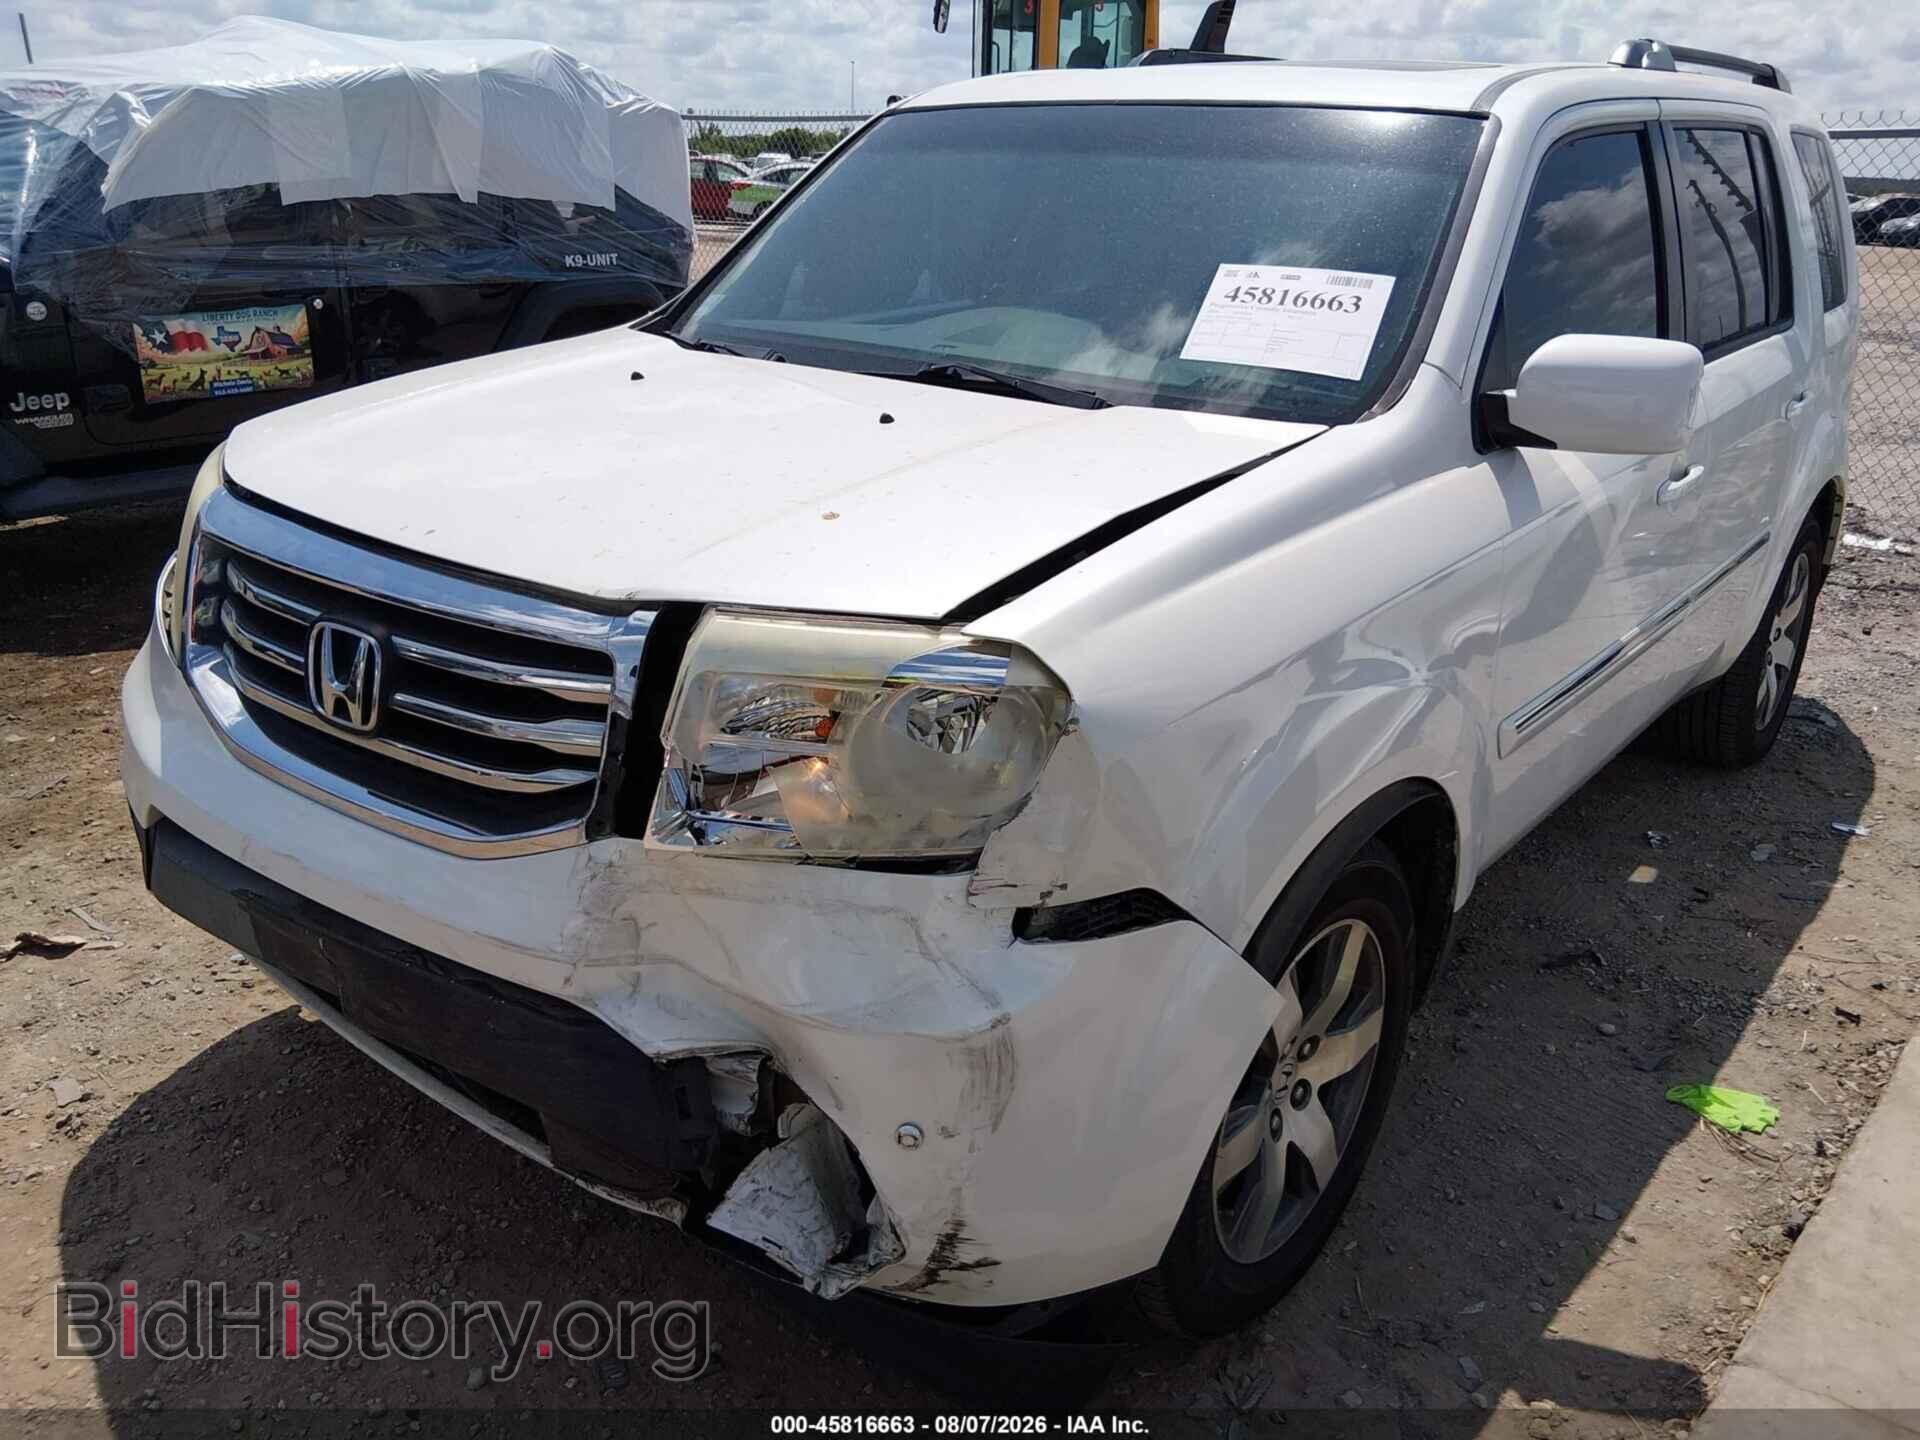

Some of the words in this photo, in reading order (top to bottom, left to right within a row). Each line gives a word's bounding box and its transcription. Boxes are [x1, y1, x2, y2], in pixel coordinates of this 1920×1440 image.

[564, 253, 619, 268] K9-UNIT
[1224, 285, 1363, 314] 45816663
[202, 311, 234, 322] LIBERTY
[253, 308, 279, 319] RANCH
[9, 391, 71, 412] Jeep
